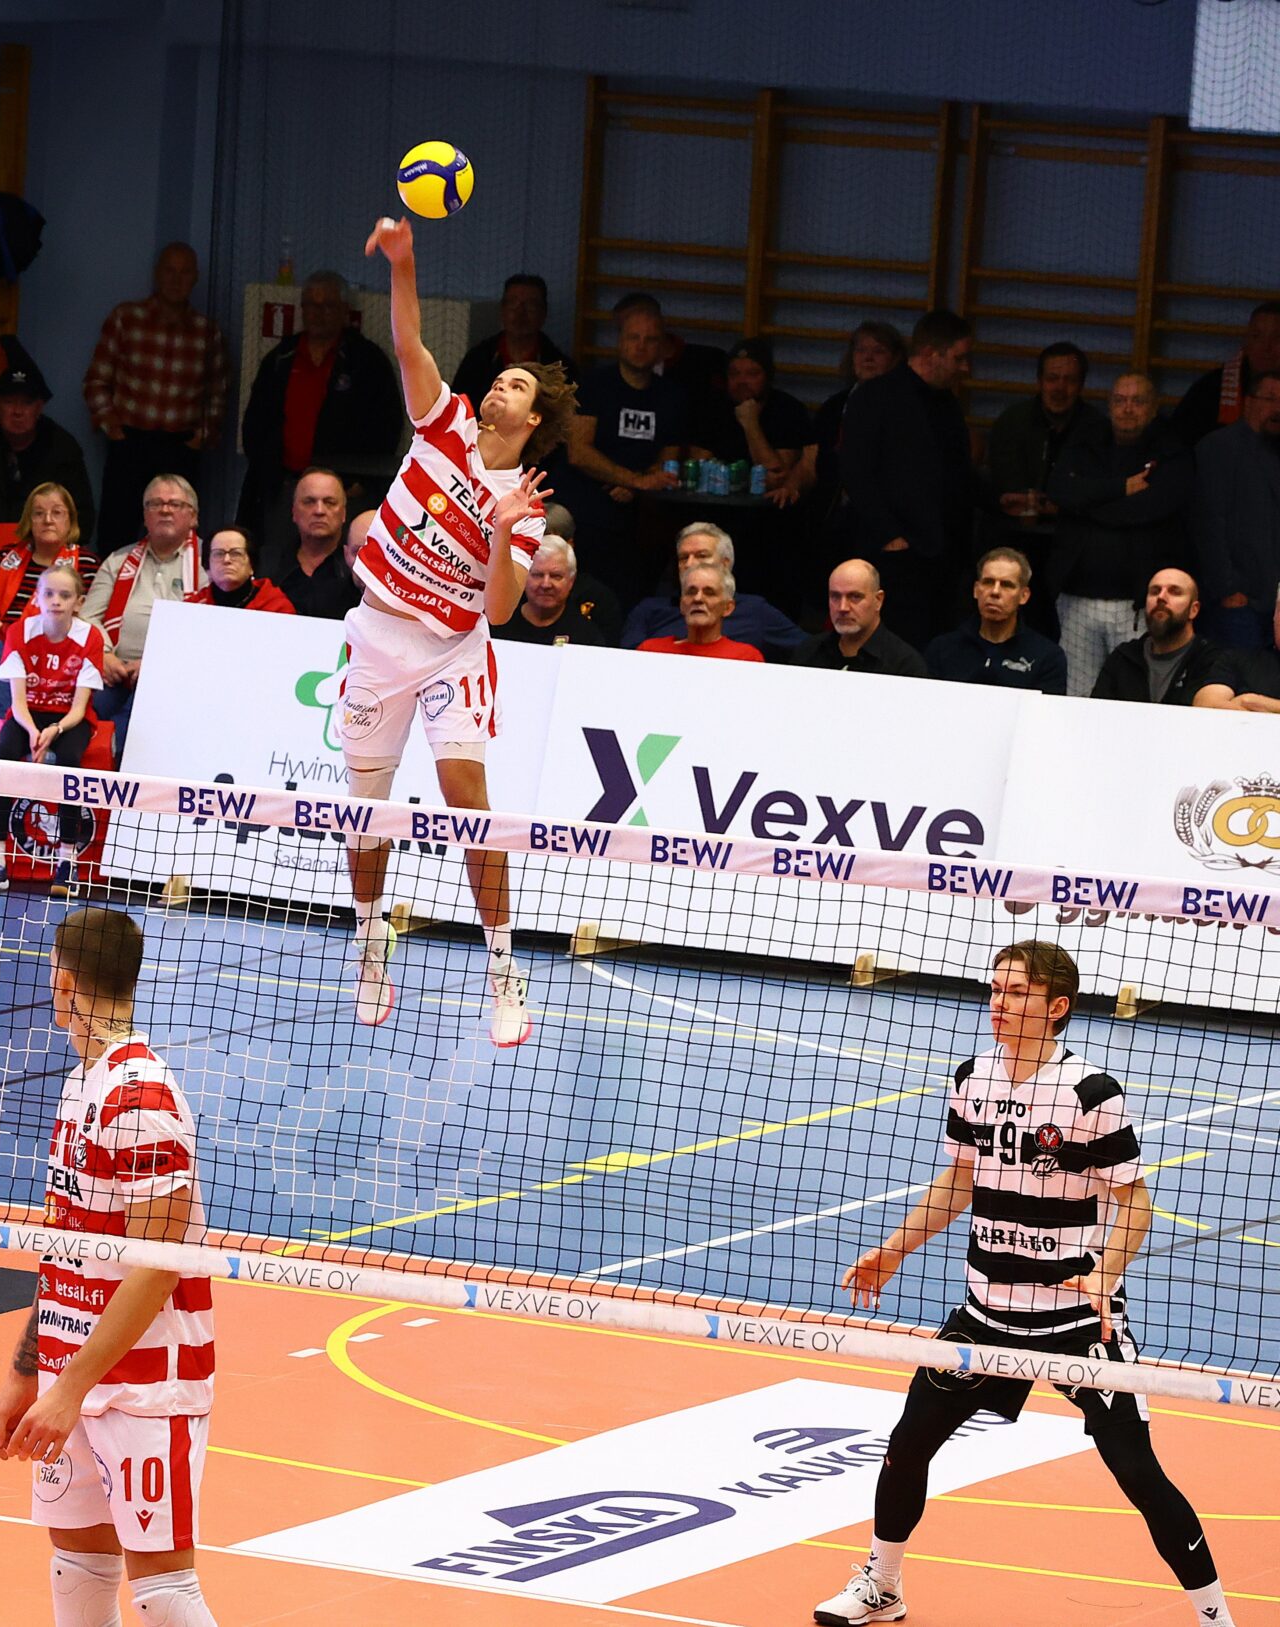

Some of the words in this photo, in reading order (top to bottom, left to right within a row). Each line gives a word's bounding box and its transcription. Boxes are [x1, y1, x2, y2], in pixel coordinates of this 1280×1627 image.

[624, 412, 650, 430] HH
[430, 532, 472, 574] Vexve
[46, 654, 59, 671] 79
[459, 674, 487, 708] 11
[692, 766, 985, 860] Vexve
[62, 773, 140, 808] BEWI
[178, 786, 257, 820] BEWI
[294, 800, 373, 833] BEWI
[411, 812, 491, 845] BEWI
[530, 822, 612, 856] BEWI
[651, 834, 733, 870] BEWI
[772, 848, 856, 881] BEWI
[927, 862, 1013, 898] BEWI
[1051, 874, 1139, 909] BEWI
[1181, 887, 1271, 922] BEWI
[999, 1121, 1017, 1165] 9
[17, 1230, 91, 1260] VEXVE
[96, 1241, 127, 1263] OY
[247, 1260, 322, 1287] VEXVE
[327, 1270, 361, 1291] OY
[484, 1288, 561, 1316] VEXVE
[566, 1299, 601, 1320] OY
[726, 1319, 807, 1349] VEXVE
[811, 1331, 846, 1353] OY
[979, 1351, 1060, 1382] VEXVE
[1066, 1363, 1102, 1386] OY
[120, 1456, 166, 1503] 10
[412, 1505, 682, 1577] FINSKA
